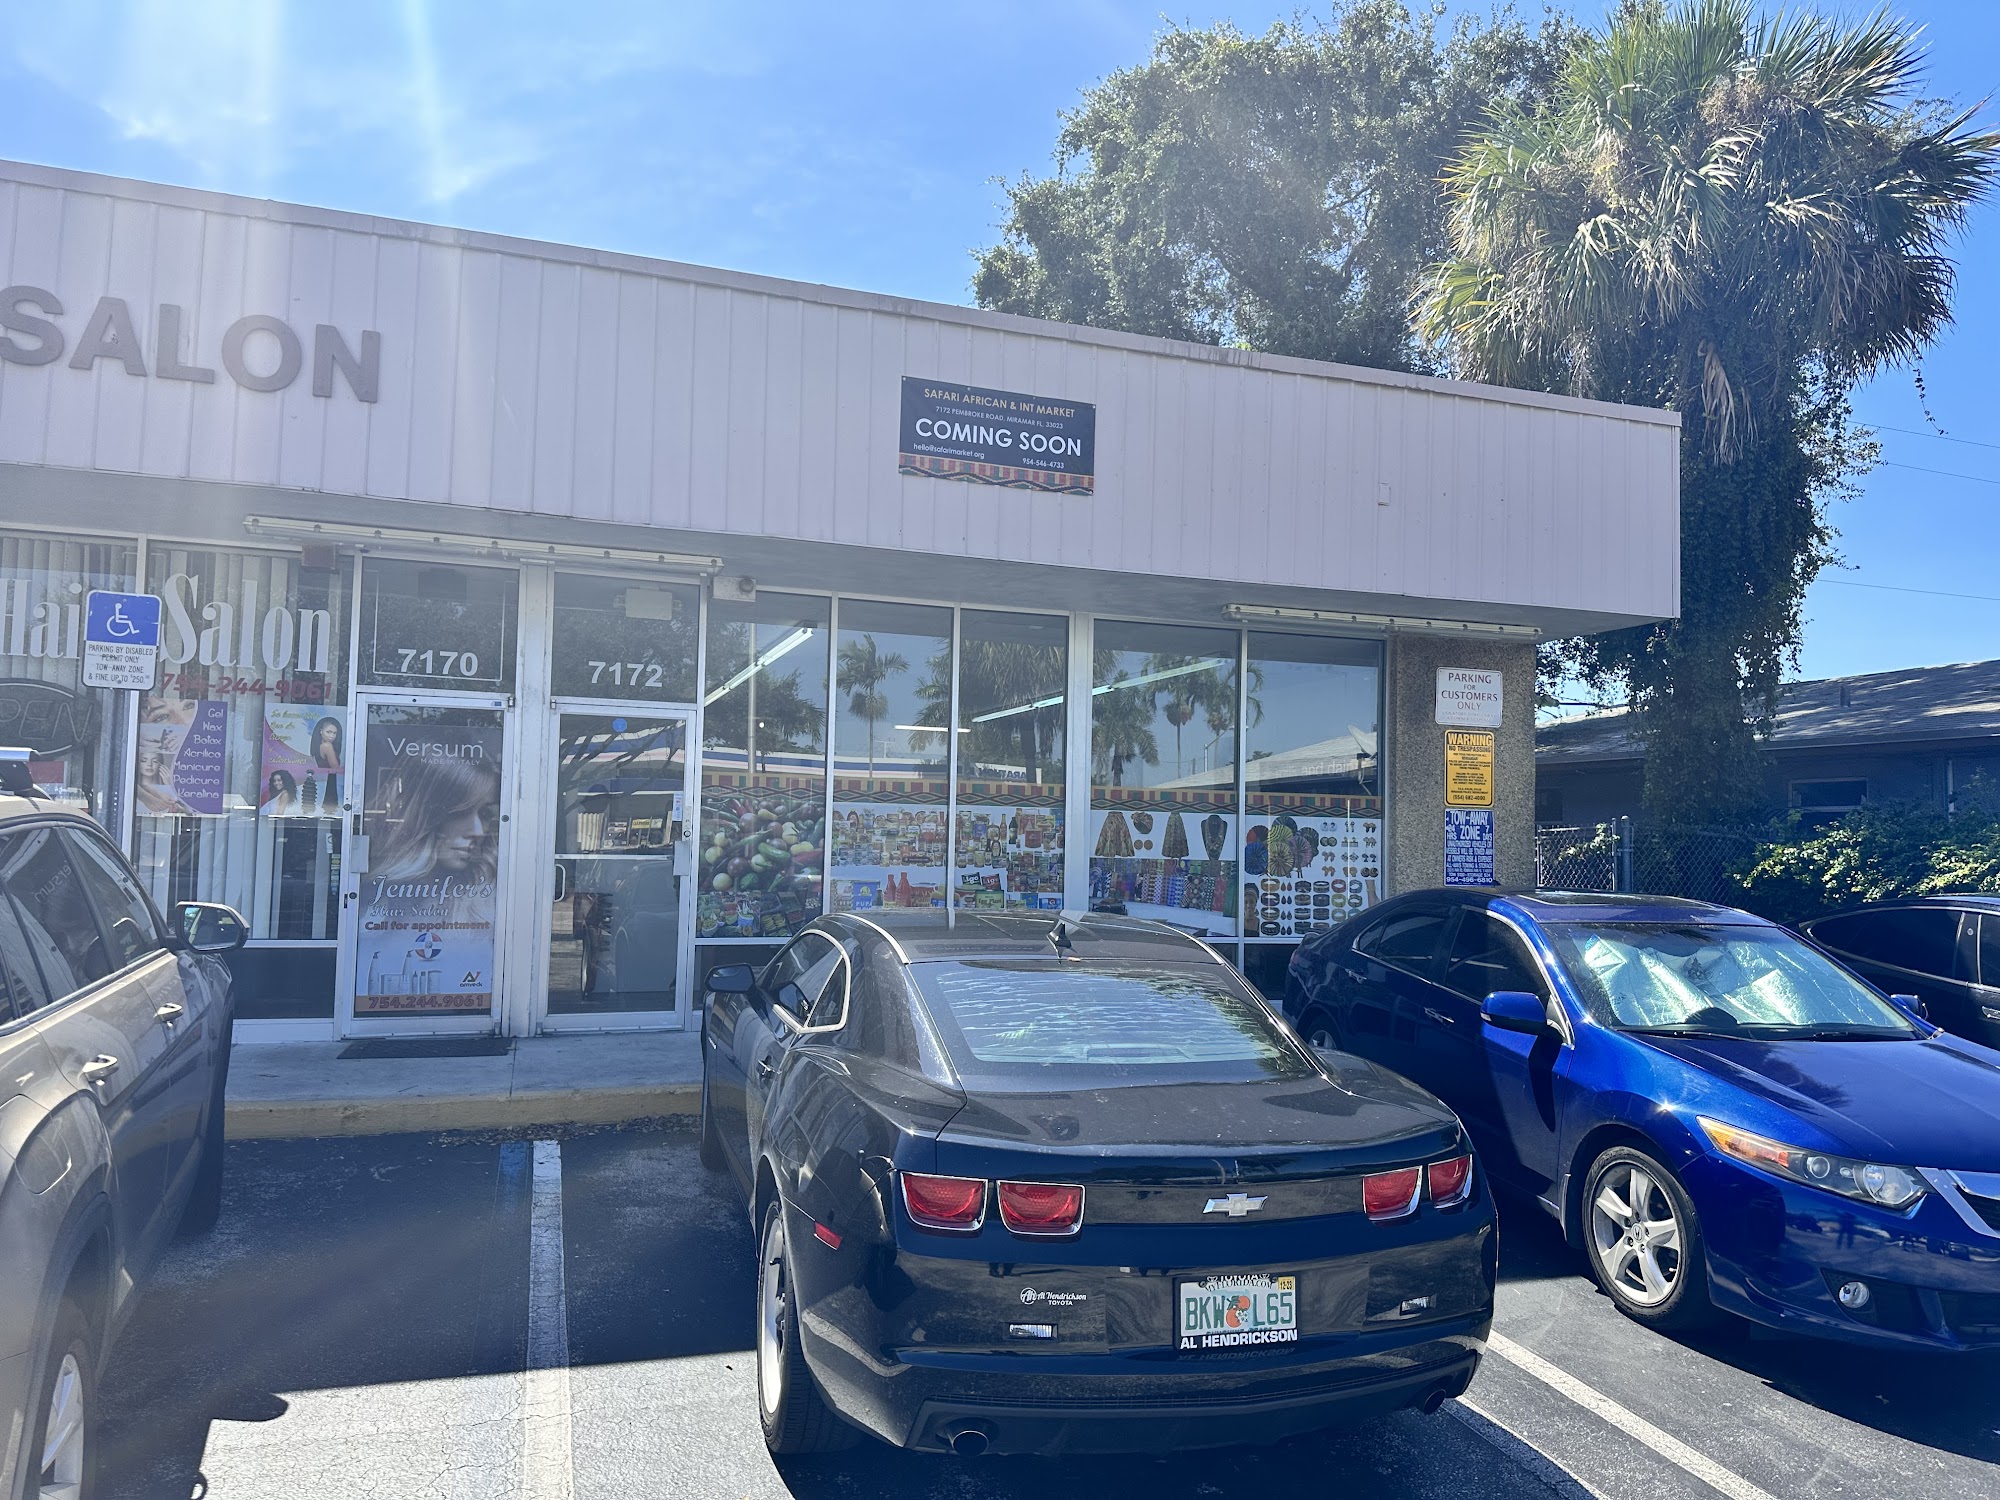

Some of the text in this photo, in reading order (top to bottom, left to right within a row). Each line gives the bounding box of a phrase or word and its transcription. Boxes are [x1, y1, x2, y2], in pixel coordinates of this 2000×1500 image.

[0, 285, 381, 404] SALON
[924, 388, 1075, 417] SAFARI AFRICAN & INT MARKET
[935, 406, 950, 414] 7172
[951, 408, 985, 419] PEMBROKE
[1006, 415, 1036, 426] MIRAMAR
[1045, 421, 1064, 429] 33023
[915, 417, 1081, 457] COMING SOON
[913, 442, 985, 459] hello@safarimarket.org
[1022, 457, 1065, 469] 954-546-4733
[0, 572, 331, 673] Hai Salon
[88, 644, 114, 654] PARKING
[126, 647, 154, 656] DISABLED
[101, 653, 140, 664] PERMIT ONLY
[398, 648, 478, 677] 7170
[96, 662, 144, 674] TOW-AWAY ZONE
[588, 660, 663, 688] 7172
[88, 672, 93, 680] &
[95, 673, 109, 681] FINE
[121, 675, 129, 683] TO
[1448, 672, 1492, 684] PARKING
[1441, 689, 1498, 702] CUSTOMERS
[1457, 701, 1482, 711] ONLY
[207, 708, 224, 719] Gel
[202, 721, 223, 732] Wax
[193, 734, 222, 745] Botox
[1448, 732, 1492, 747] WARNING
[183, 747, 221, 759] Acrilico
[387, 737, 483, 758] Versum
[1457, 745, 1491, 753] TRESPASSING
[174, 760, 221, 772] Manicure
[173, 774, 220, 785] Pedicure
[177, 787, 220, 799] Keratina
[1450, 810, 1489, 826] TOW-AWAY
[1460, 825, 1480, 840] ZONE
[1485, 825, 1490, 834] 7
[368, 874, 493, 905] Jennifer's
[370, 904, 449, 917] Hair Salon
[365, 920, 490, 932] Call for appointment
[368, 993, 484, 1010] 754.244.9061
[1205, 1279, 1273, 1292] MYFLORIDA.COM
[1046, 1291, 1087, 1300] Hendrickson
[1185, 1291, 1292, 1331] BKW L65
[1180, 1336, 1197, 1350] AL
[1202, 1329, 1298, 1348] HENDRICKSON
